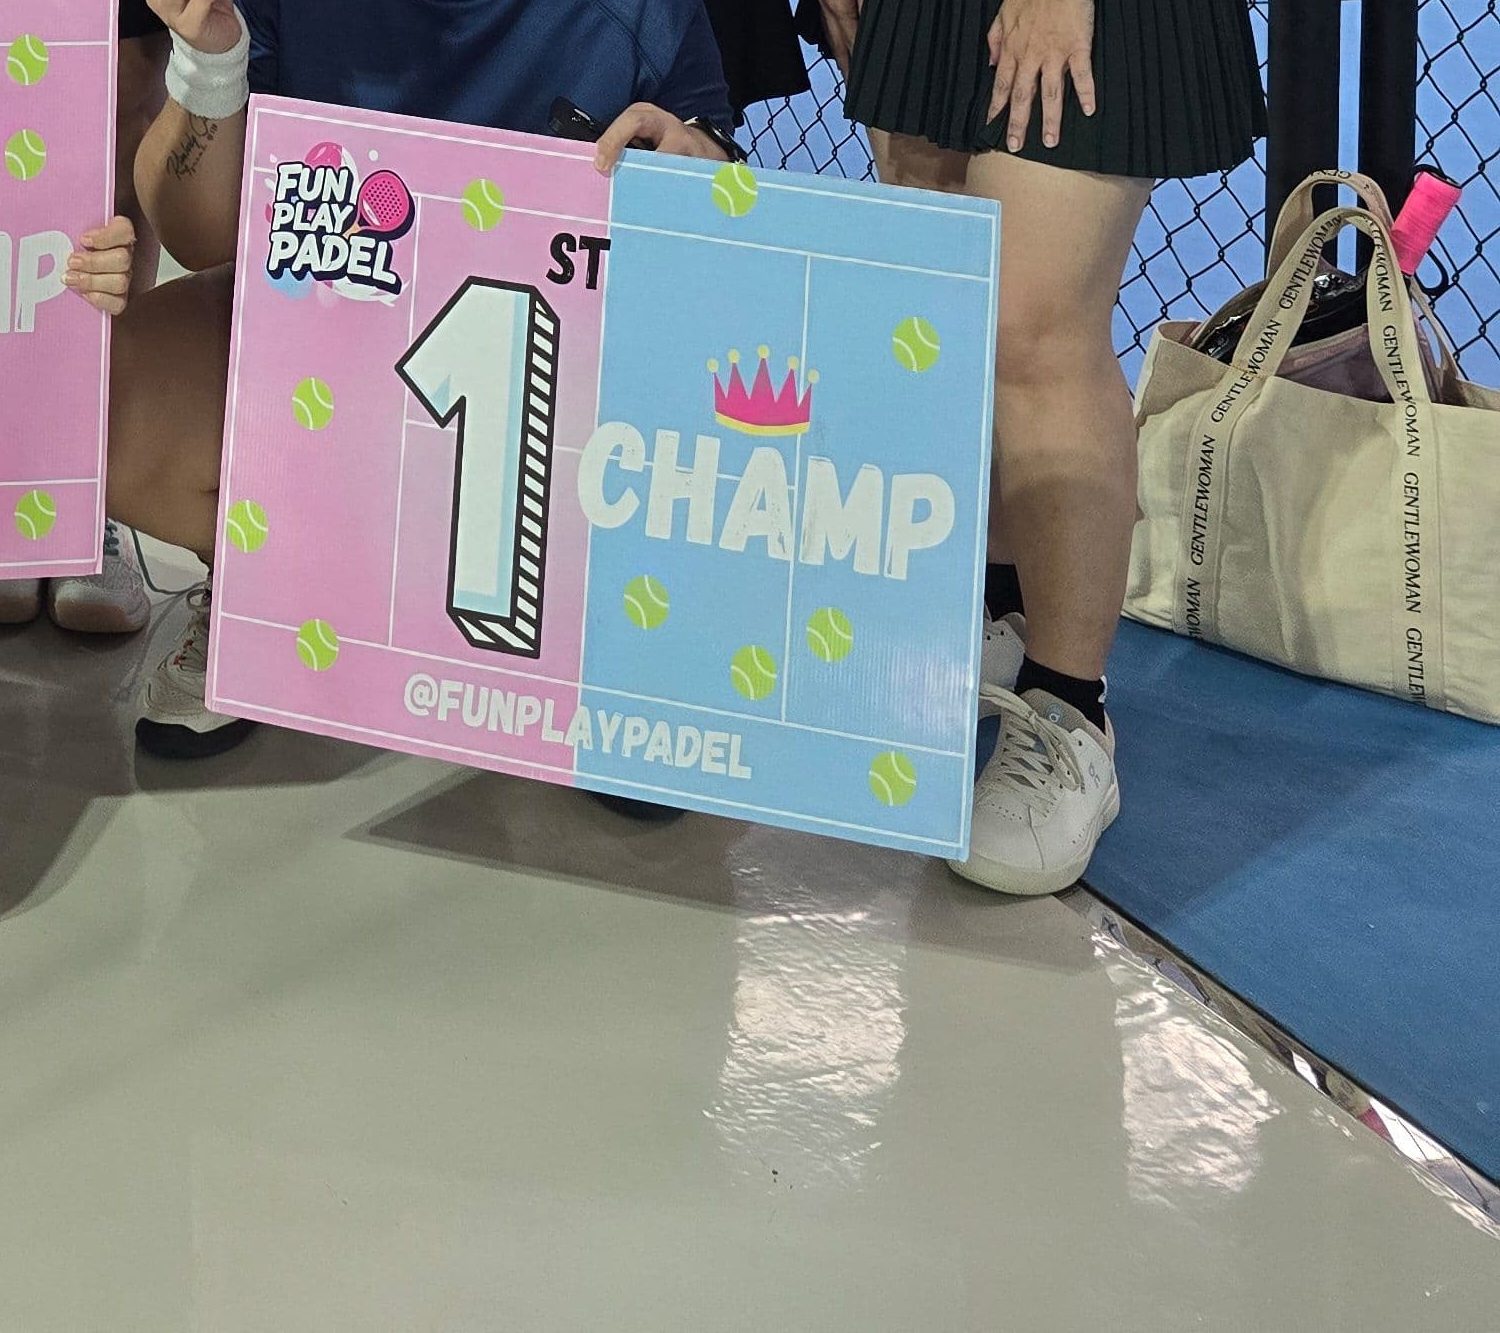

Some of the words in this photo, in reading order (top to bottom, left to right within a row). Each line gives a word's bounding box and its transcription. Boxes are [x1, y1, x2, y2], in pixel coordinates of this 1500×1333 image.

[271, 201, 354, 234] PLAY
[276, 163, 350, 203] FUN
[268, 231, 398, 285] PADEL
[1190, 434, 1216, 566] GENTLEWOMAN
[1211, 319, 1282, 424] GENTLEWOMAN
[1382, 324, 1421, 457] GENTLEWOMAN
[1403, 471, 1422, 614] GENTLEWOMAN
[576, 420, 956, 581] CHAMP
[403, 671, 753, 780] @FUNPLAYPADEL
